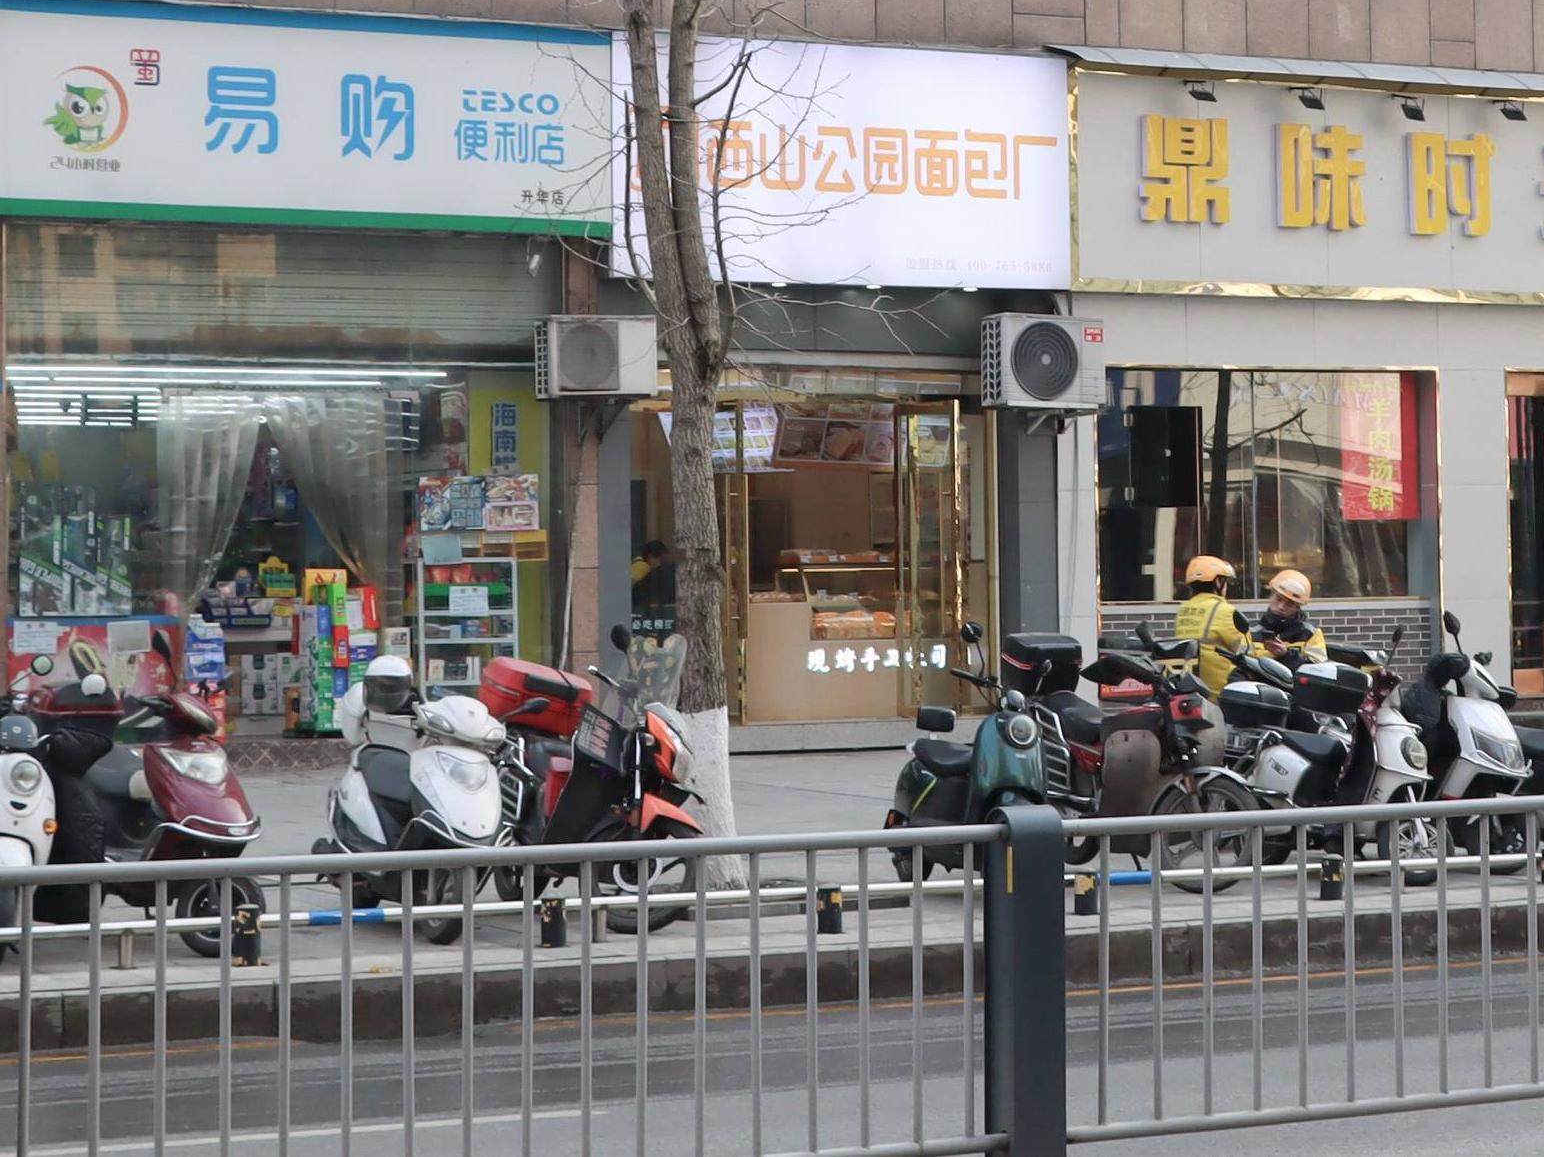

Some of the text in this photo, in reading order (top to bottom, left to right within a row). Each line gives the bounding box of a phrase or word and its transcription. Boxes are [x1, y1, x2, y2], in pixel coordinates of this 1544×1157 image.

[204, 65, 416, 162] 易购
[462, 89, 560, 116] TESCO
[454, 119, 564, 165] 便利店
